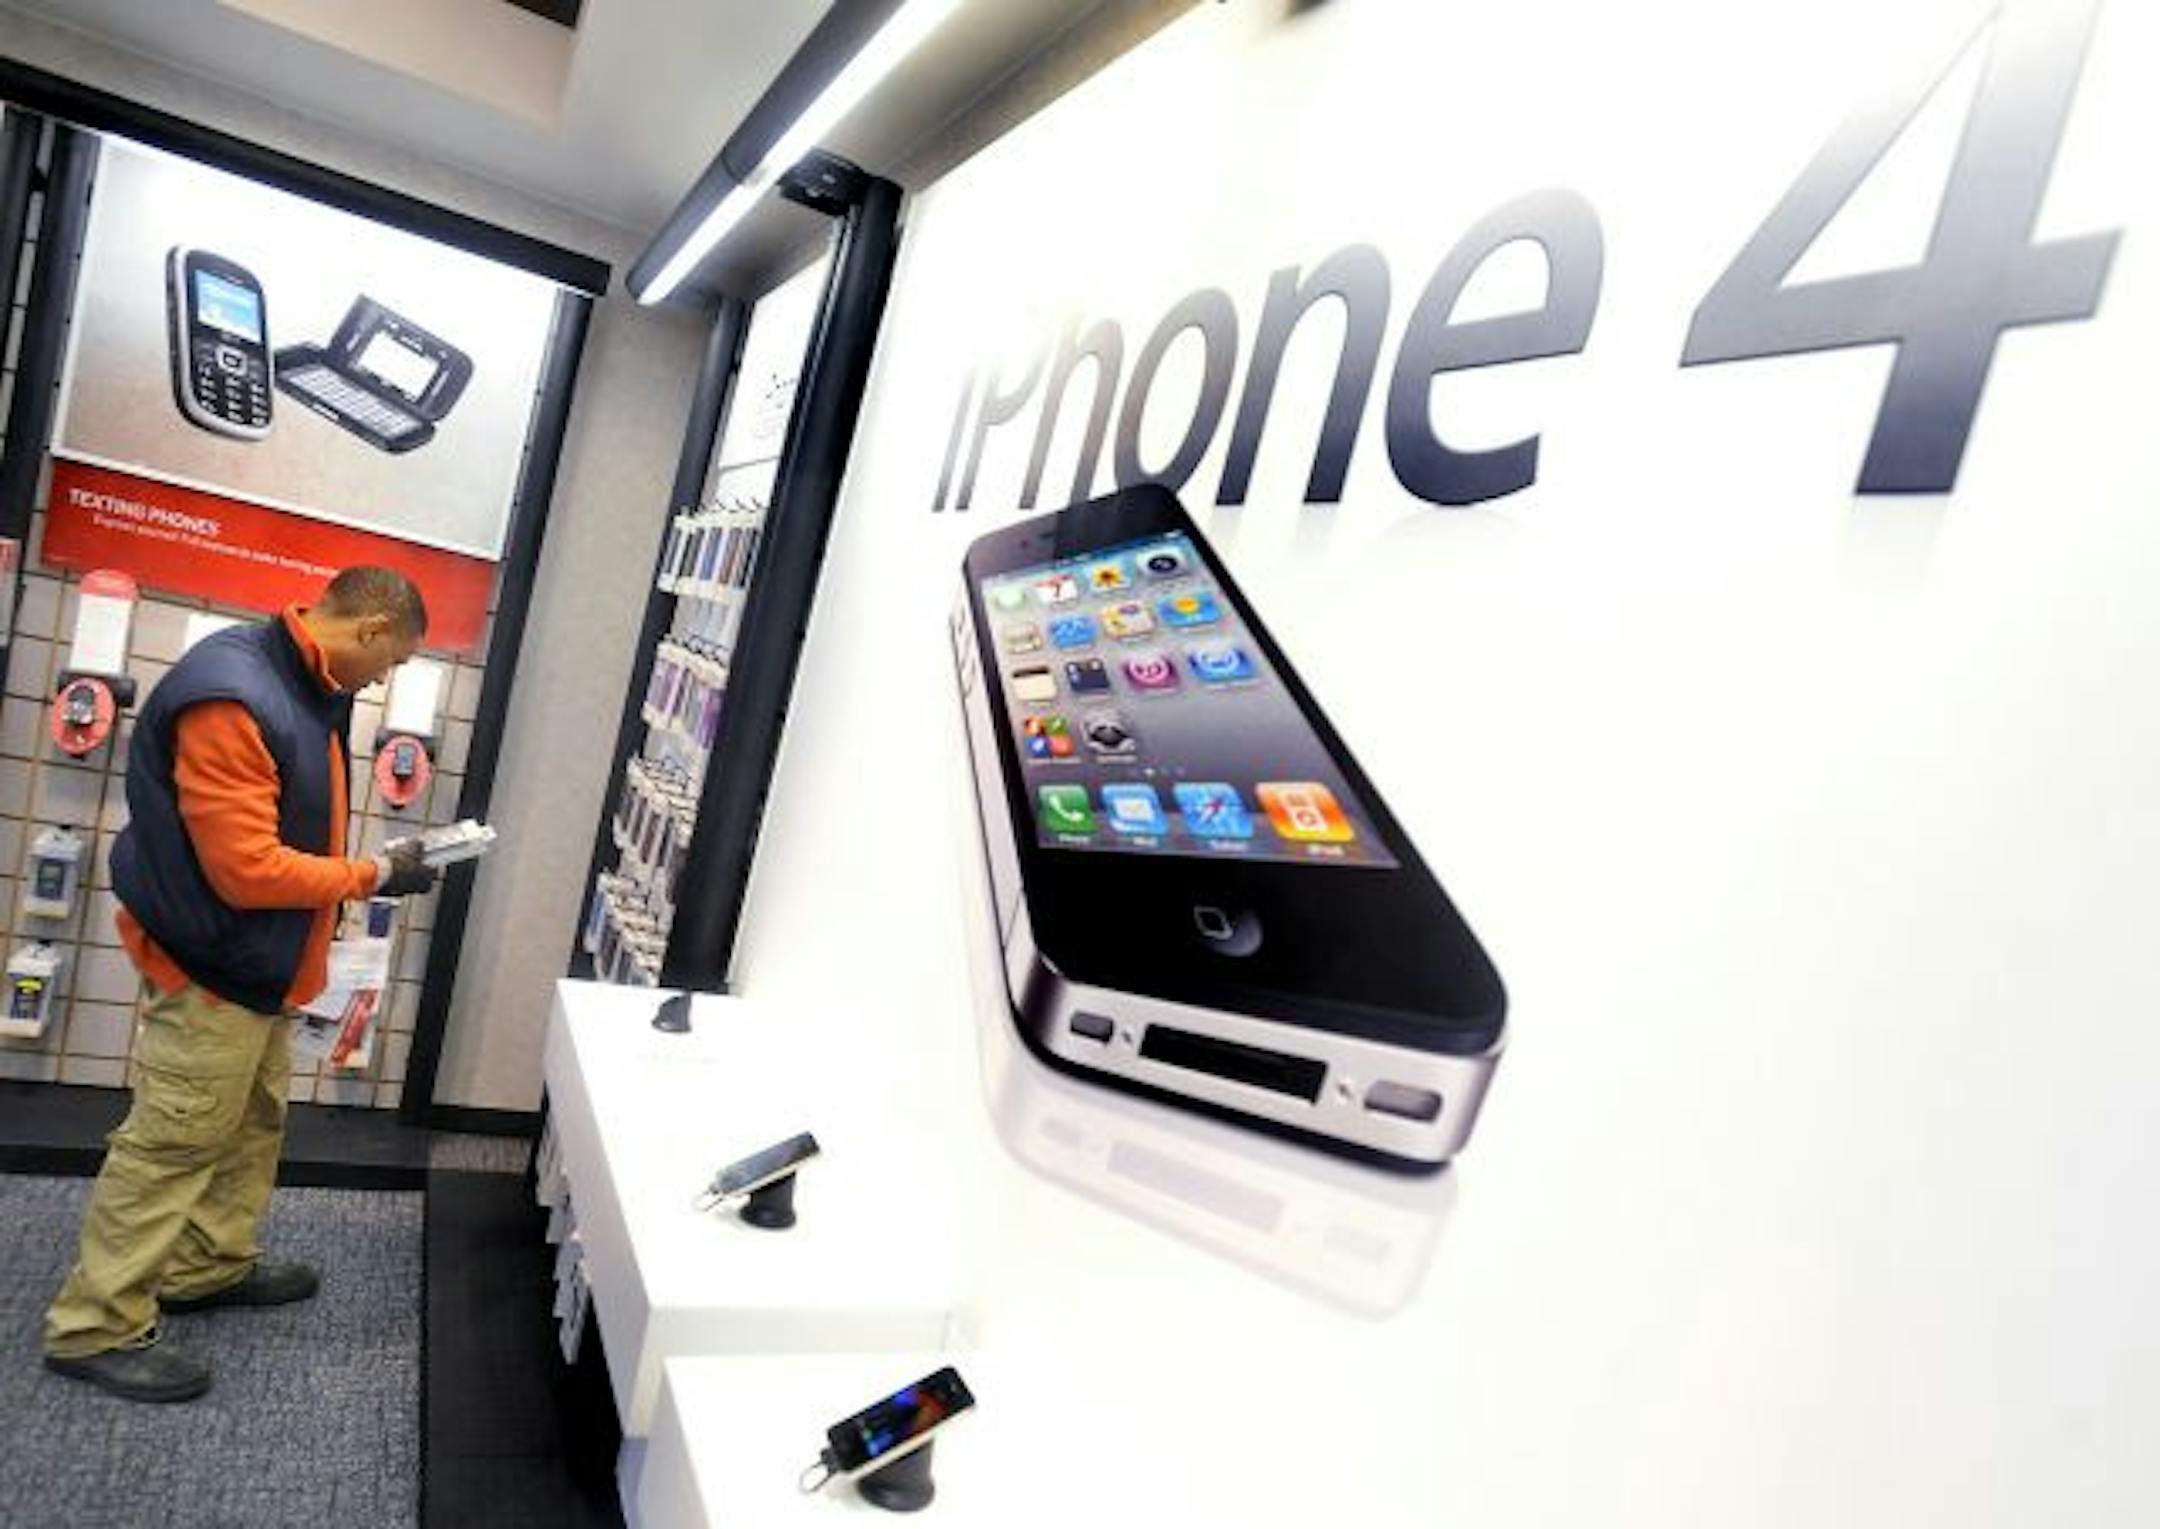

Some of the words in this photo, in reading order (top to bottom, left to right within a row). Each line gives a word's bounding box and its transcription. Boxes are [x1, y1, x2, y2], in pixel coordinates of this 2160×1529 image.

[931, 187, 1605, 513] iPhone
[1679, 0, 2122, 496] 4
[69, 487, 146, 519] TEXTING
[147, 506, 221, 535] PHONES
